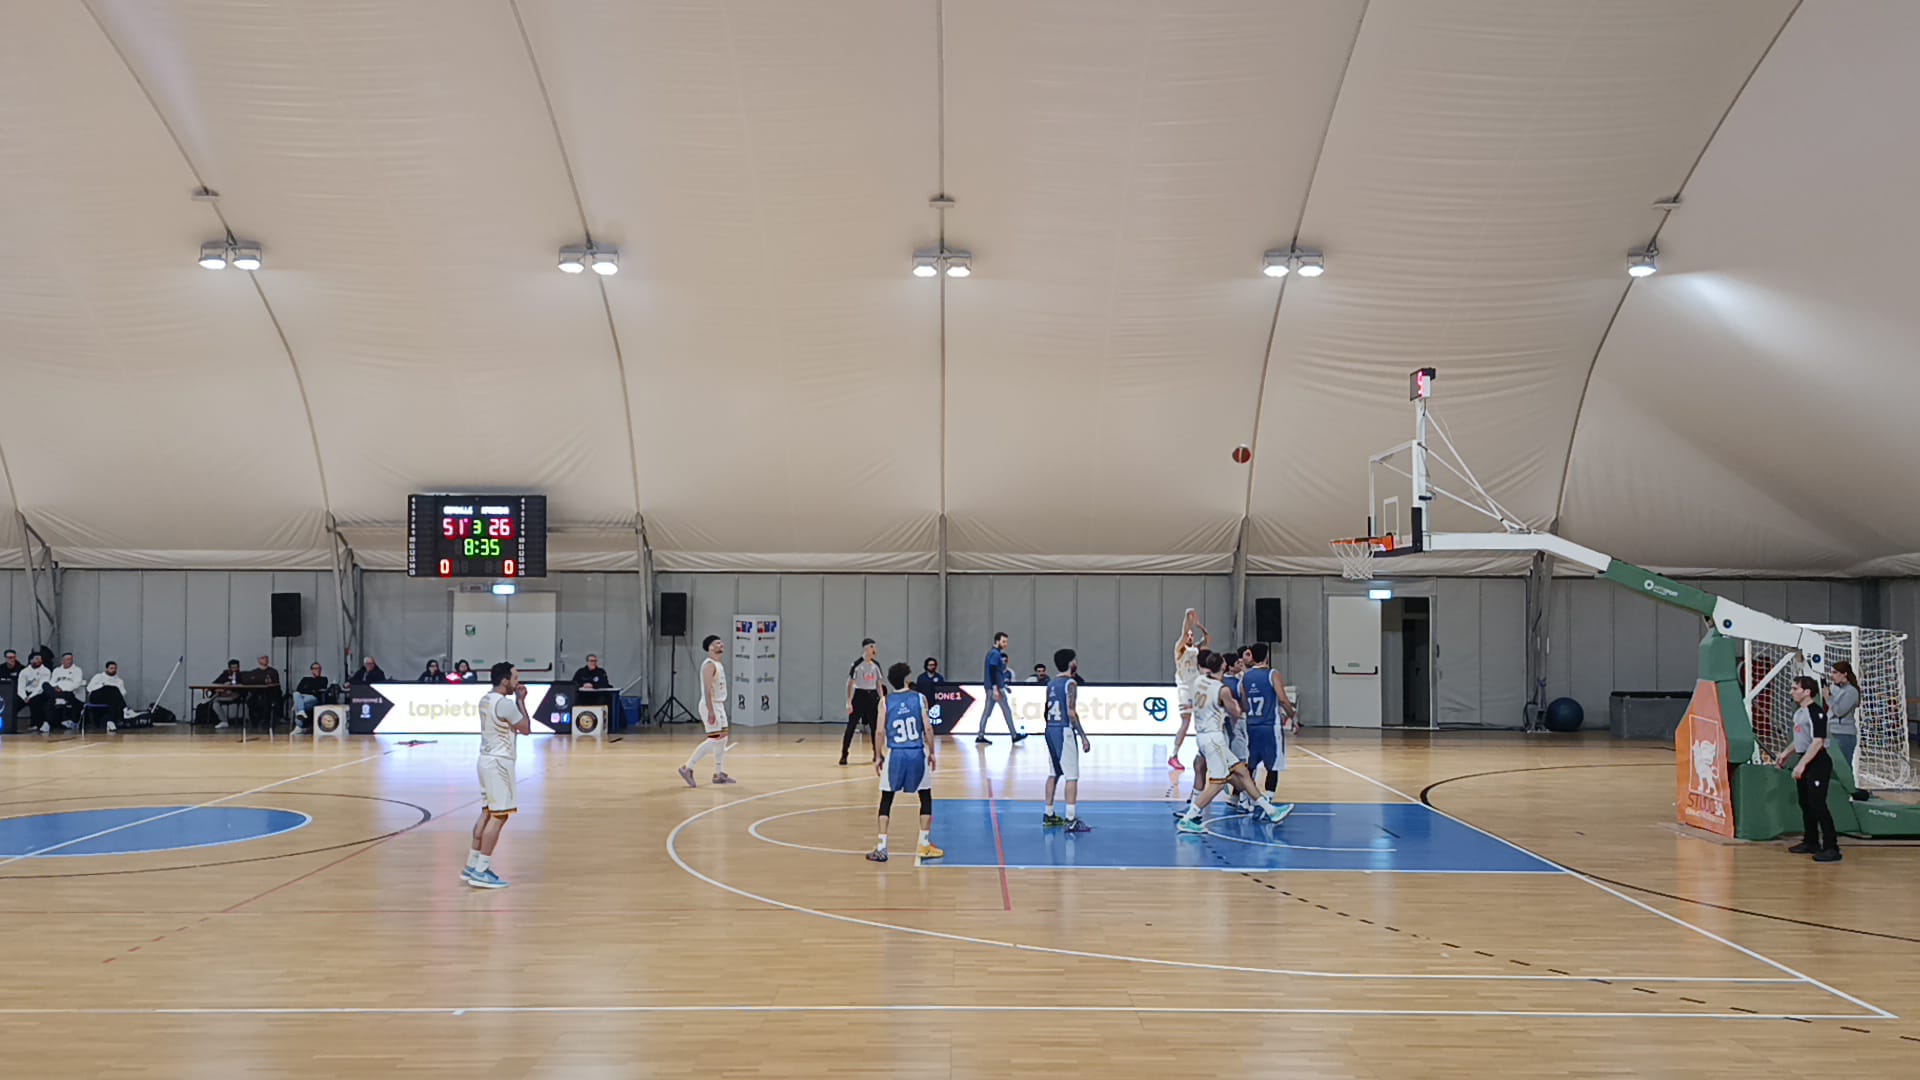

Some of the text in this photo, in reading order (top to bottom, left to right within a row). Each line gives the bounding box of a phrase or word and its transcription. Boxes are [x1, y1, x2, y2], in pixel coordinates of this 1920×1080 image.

[473, 519, 482, 535] 3
[489, 518, 511, 536] 26
[464, 538, 500, 556] 8:35
[440, 559, 514, 575] 0 0
[408, 698, 480, 720] Lapietr
[1011, 697, 1139, 721] Laetra
[1247, 697, 1265, 716] 17
[892, 716, 920, 744] 30
